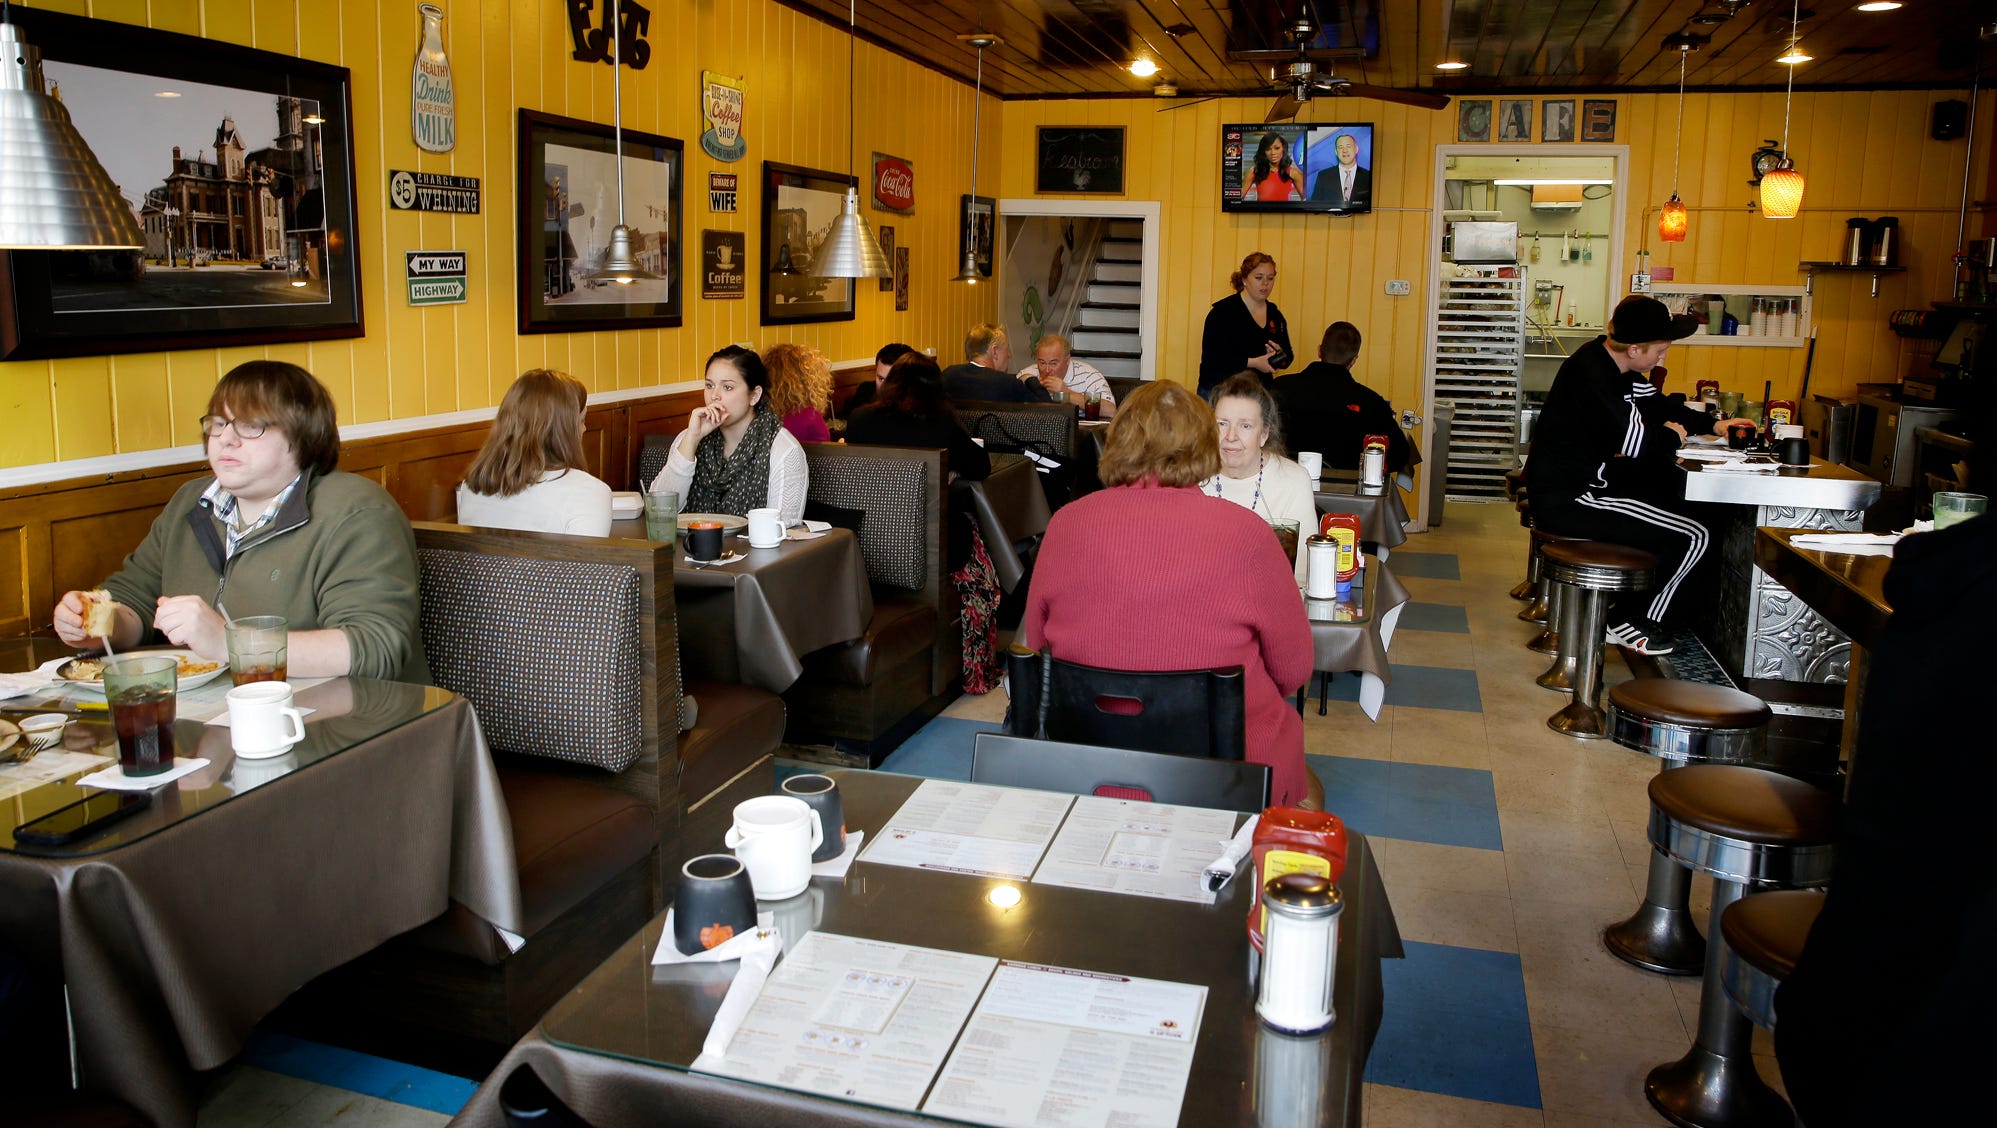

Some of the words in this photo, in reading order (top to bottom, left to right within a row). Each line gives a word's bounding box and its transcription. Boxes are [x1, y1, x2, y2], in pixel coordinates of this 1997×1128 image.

[567, 0, 651, 70] EAT
[420, 60, 449, 77] HEALTHY
[416, 73, 452, 104] Drink
[417, 102, 433, 114] PURE
[434, 104, 453, 116] FRESH
[711, 100, 741, 125] Coffee
[418, 112, 453, 146] MILK
[1460, 102, 1615, 141] CAFE
[718, 127, 735, 140] SHOP
[417, 173, 455, 187] CHARGE
[460, 179, 477, 189] FOR
[395, 179, 412, 204] $5
[417, 187, 478, 213] WHINING
[711, 192, 737, 211] WIFE
[419, 260, 435, 270] MY
[439, 259, 460, 270] WAY
[708, 271, 742, 284] Coffee
[414, 285, 459, 297] HIGHWAY
